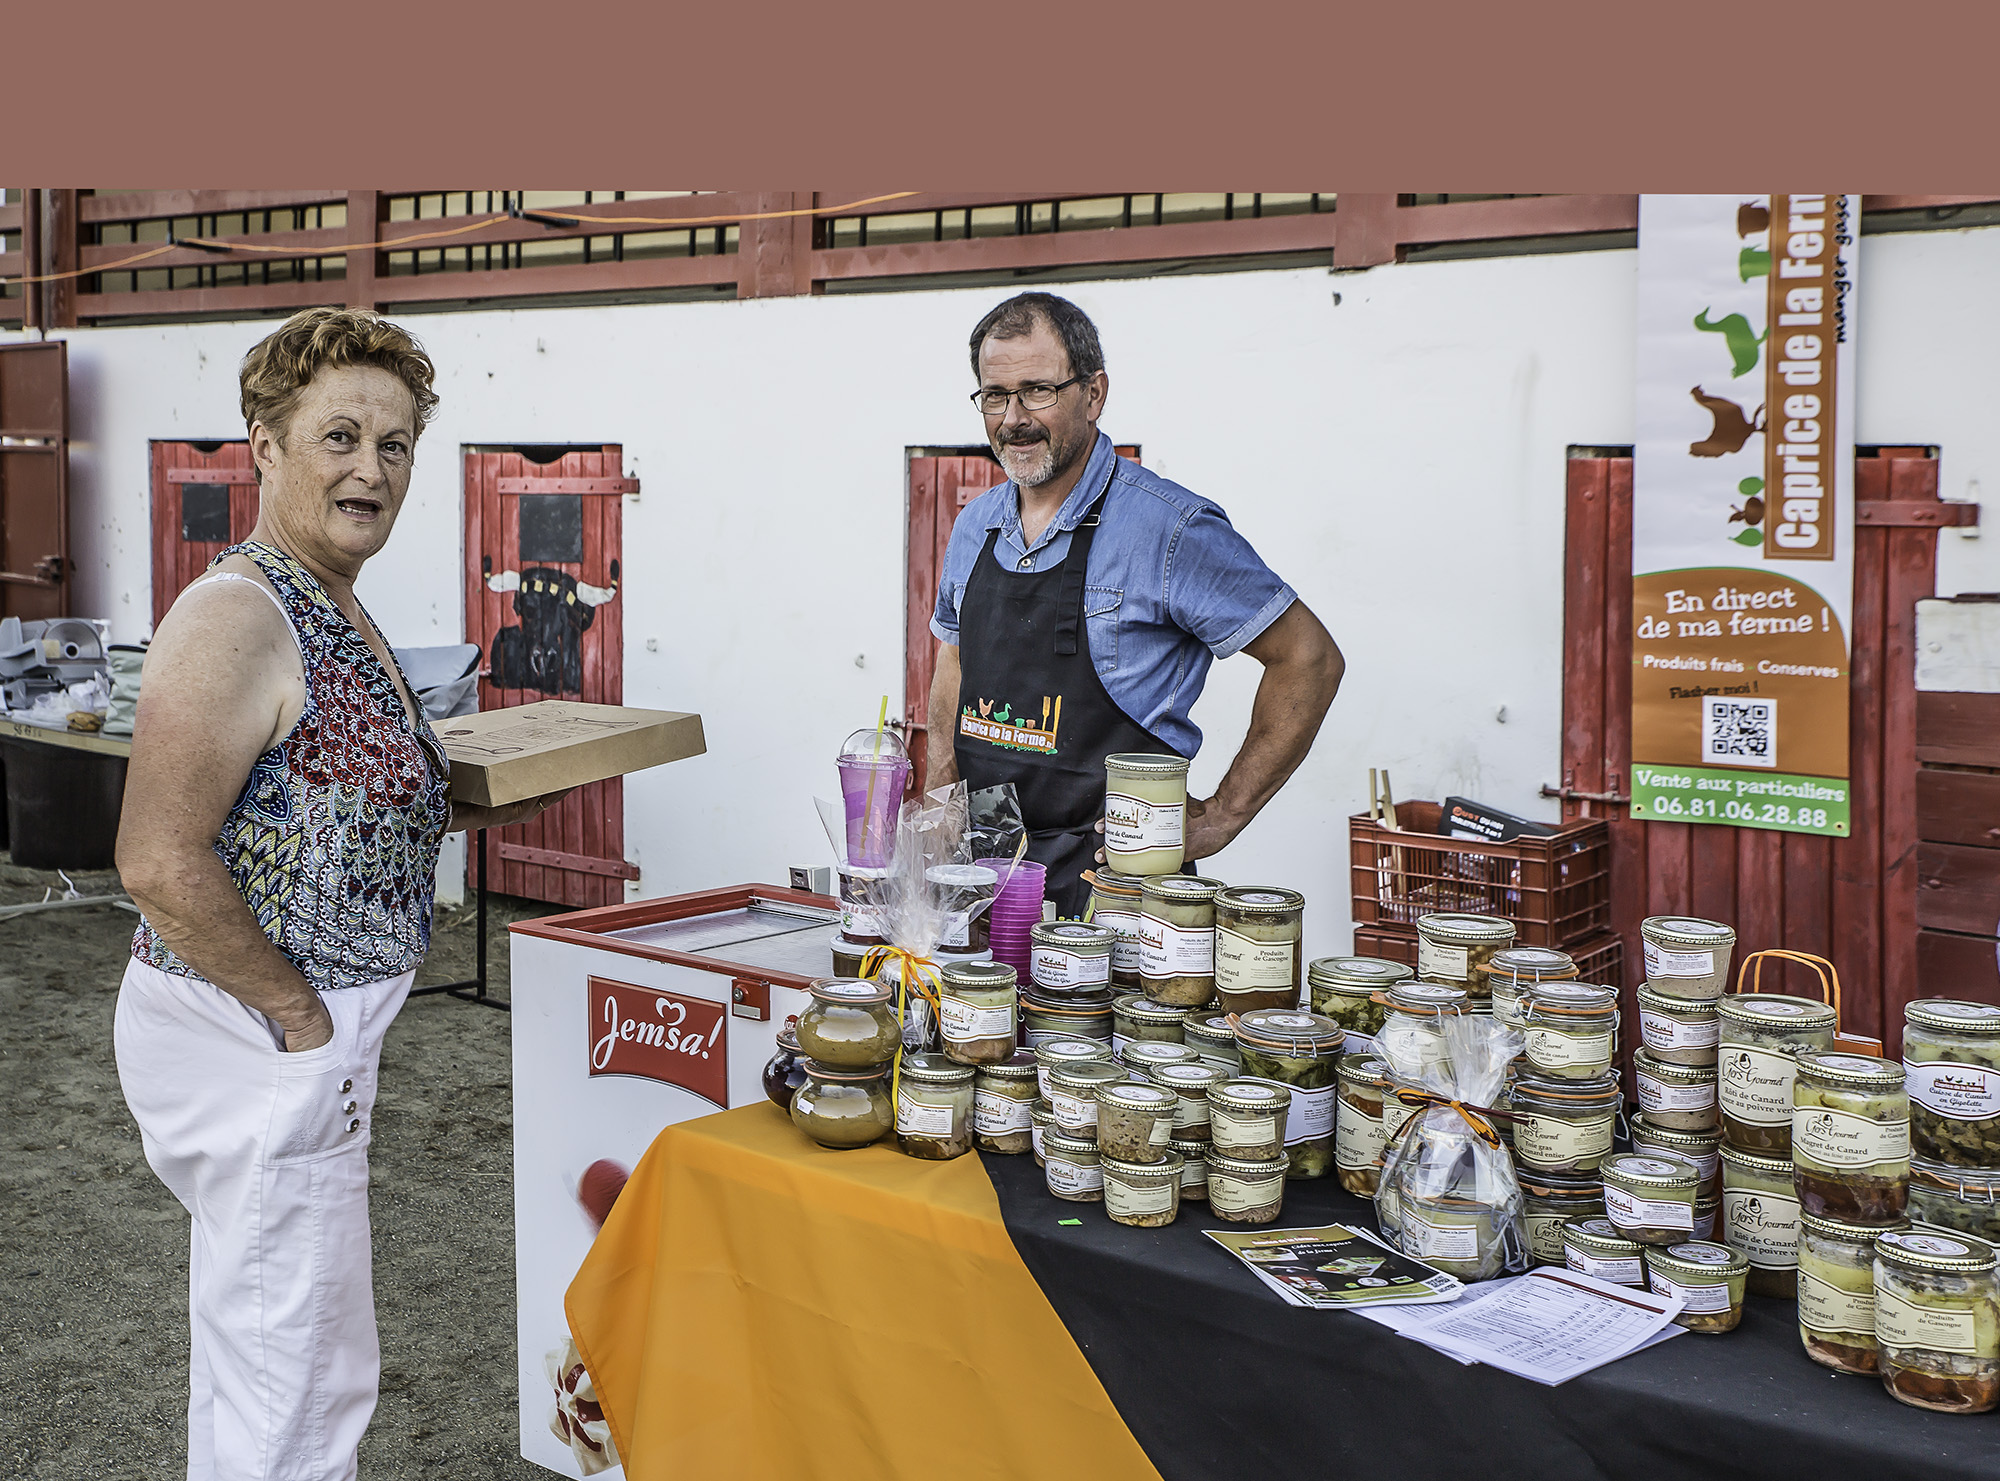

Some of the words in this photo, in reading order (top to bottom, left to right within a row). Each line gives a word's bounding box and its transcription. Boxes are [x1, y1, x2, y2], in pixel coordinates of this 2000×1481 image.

[1833, 254, 1852, 343] manger
[1778, 287, 1824, 326] la
[1777, 333, 1823, 386] de
[1774, 394, 1825, 549] Caprice
[1665, 590, 1705, 614] En
[1712, 587, 1797, 611] direct
[1637, 616, 1671, 639] de
[1678, 618, 1722, 638] ma
[1728, 612, 1814, 636] ferme
[1821, 607, 1830, 632] !
[1643, 655, 1707, 671] Produits
[1710, 657, 1744, 673] frais
[1757, 660, 1841, 678] Conserves
[1724, 685, 1750, 696] moi
[962, 718, 988, 736] Caprice
[989, 725, 1000, 739] de
[1001, 728, 1011, 741] la
[1635, 770, 1692, 789] Vente
[1696, 778, 1731, 792] aux
[1735, 780, 1846, 803] particuliers
[1653, 795, 1827, 828] 06.81.06.28.88
[1121, 830, 1144, 840] Canard
[593, 995, 724, 1069] Jemsa!
[1746, 1067, 1789, 1086] Gourmet
[1929, 1087, 1952, 1096] Cuisse
[1751, 1094, 1784, 1104] Canard
[1746, 1103, 1774, 1112] poivre
[984, 1116, 1007, 1125] Canard
[1829, 1125, 1862, 1139] Gourmet
[1525, 1140, 1538, 1148] Foie
[1800, 1137, 1823, 1148] Magret
[1825, 1143, 1835, 1151] de
[1837, 1145, 1868, 1155] Canard
[1525, 1148, 1543, 1157] canard
[1758, 1212, 1797, 1229] Gourmet
[1751, 1236, 1761, 1244] de
[1763, 1238, 1797, 1247] Canard
[1759, 1248, 1788, 1256] poivre
[1809, 1307, 1834, 1320] Canard
[1924, 1313, 1954, 1321] Produits
[1882, 1322, 1906, 1336] Canard
[1928, 1320, 1961, 1328] Gascogne
